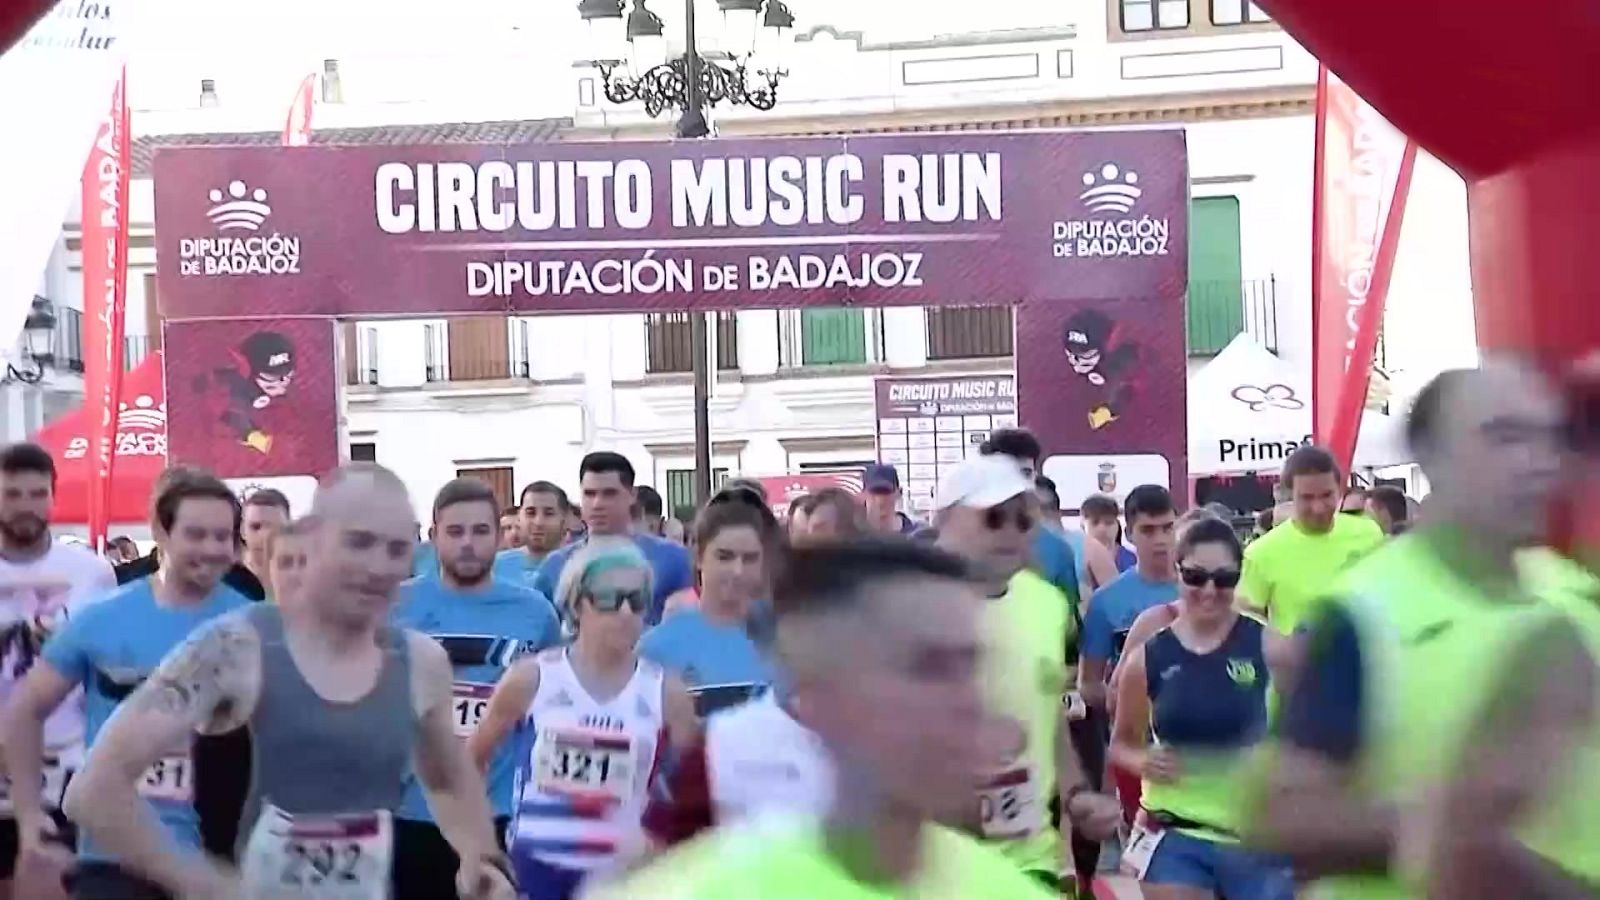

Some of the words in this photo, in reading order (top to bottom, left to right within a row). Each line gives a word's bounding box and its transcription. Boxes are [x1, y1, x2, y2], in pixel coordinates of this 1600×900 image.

[375, 159, 652, 234] CIRCUITO
[670, 154, 864, 227] MUSIC
[883, 152, 1002, 222] RUN
[1053, 215, 1168, 240] DIPUTACIÓN
[180, 232, 300, 257] DIPUTACIÓN
[1053, 243, 1073, 256] DE
[1077, 237, 1168, 256] BADAJOZ
[181, 260, 201, 275] DE
[204, 255, 300, 275] BADAJOZ
[467, 249, 693, 296] DIPUTACIÓN
[703, 265, 738, 292] DE
[749, 253, 923, 291] BADAJOZ
[889, 383, 950, 401] CIRCUITO
[951, 381, 995, 398] MUSIC
[998, 380, 1014, 397] RU
[552, 751, 611, 783] 321
